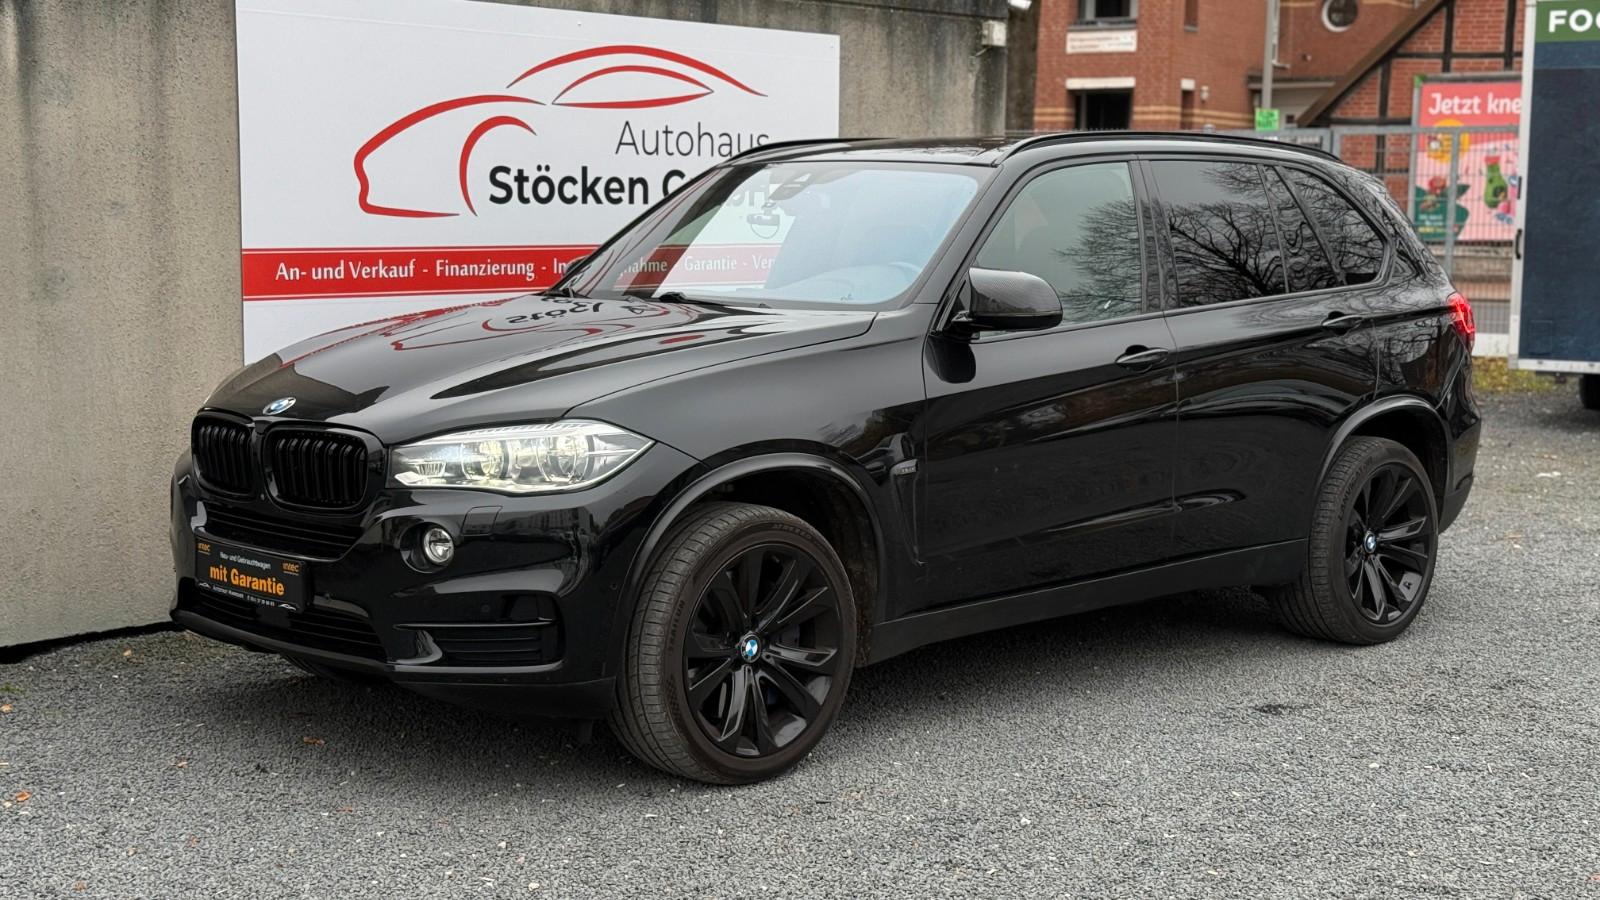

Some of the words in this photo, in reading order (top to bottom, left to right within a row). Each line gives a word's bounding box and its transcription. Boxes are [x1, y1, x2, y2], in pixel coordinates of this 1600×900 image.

[1549, 9, 1600, 32] FO
[1428, 92, 1482, 115] Jetzt
[1487, 91, 1522, 115] kne
[489, 164, 649, 205] Stöcken
[275, 262, 307, 281] An-
[311, 260, 344, 280] und
[349, 259, 416, 279] Verkauf
[436, 258, 535, 281] Finanzierung
[684, 255, 737, 271] Garantie
[209, 564, 228, 583] mit
[230, 568, 285, 596] Garantie
